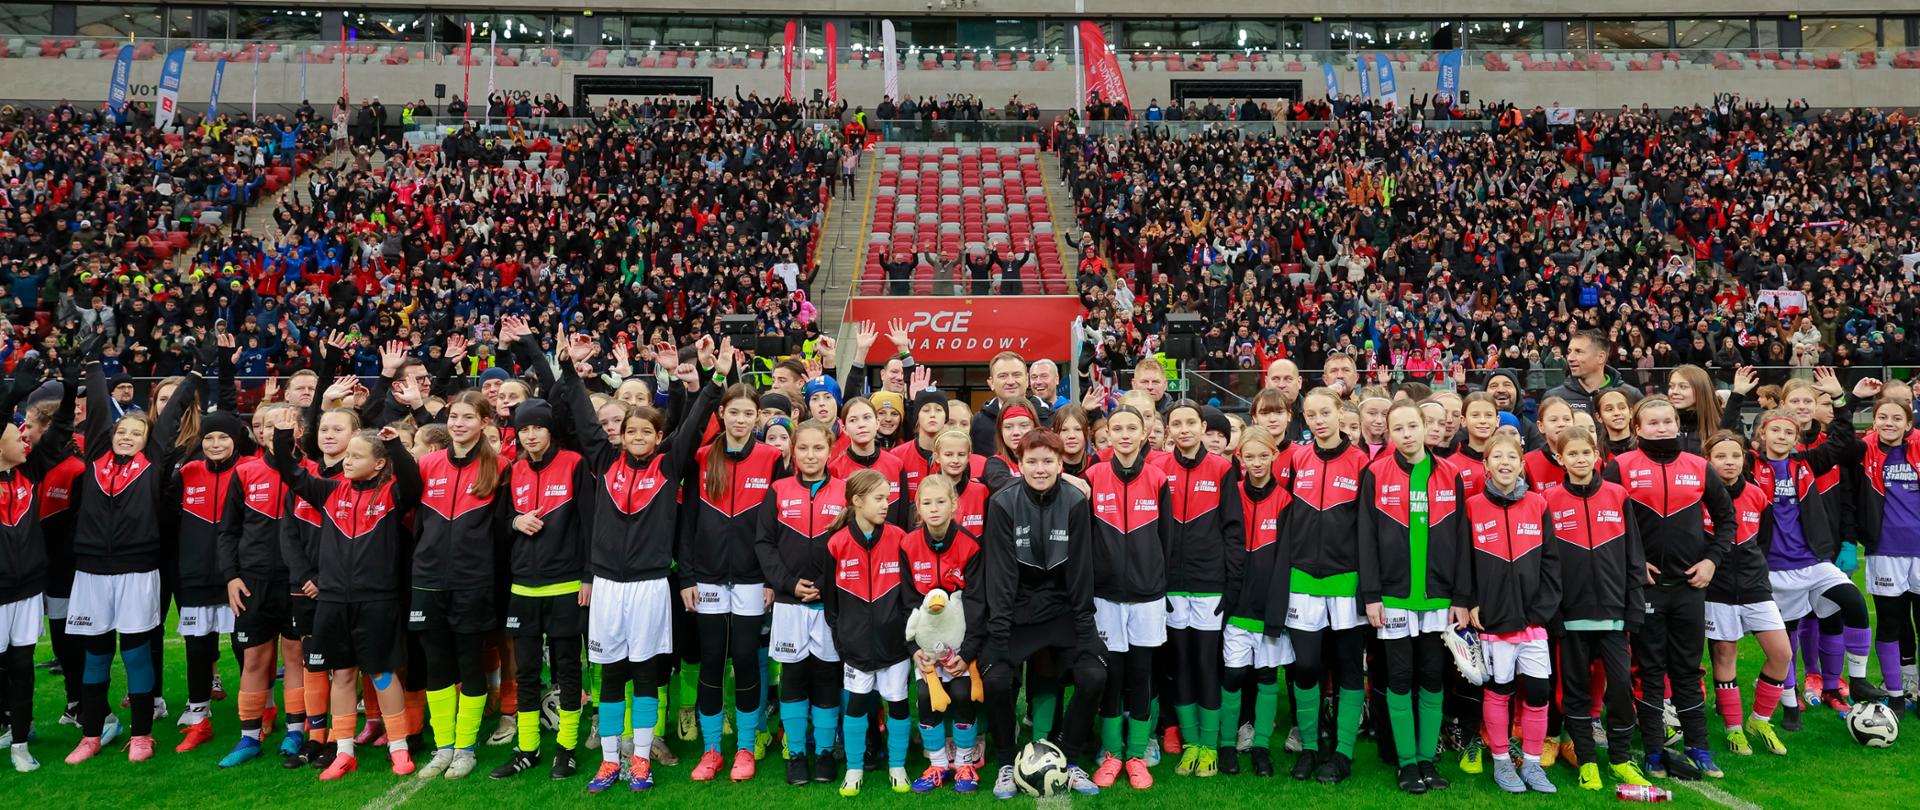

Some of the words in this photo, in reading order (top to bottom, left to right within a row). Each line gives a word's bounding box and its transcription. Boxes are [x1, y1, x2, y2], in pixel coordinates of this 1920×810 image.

[129, 84, 158, 97] V01
[908, 311, 973, 332] PGE
[908, 337, 1029, 349] NARODOWY
